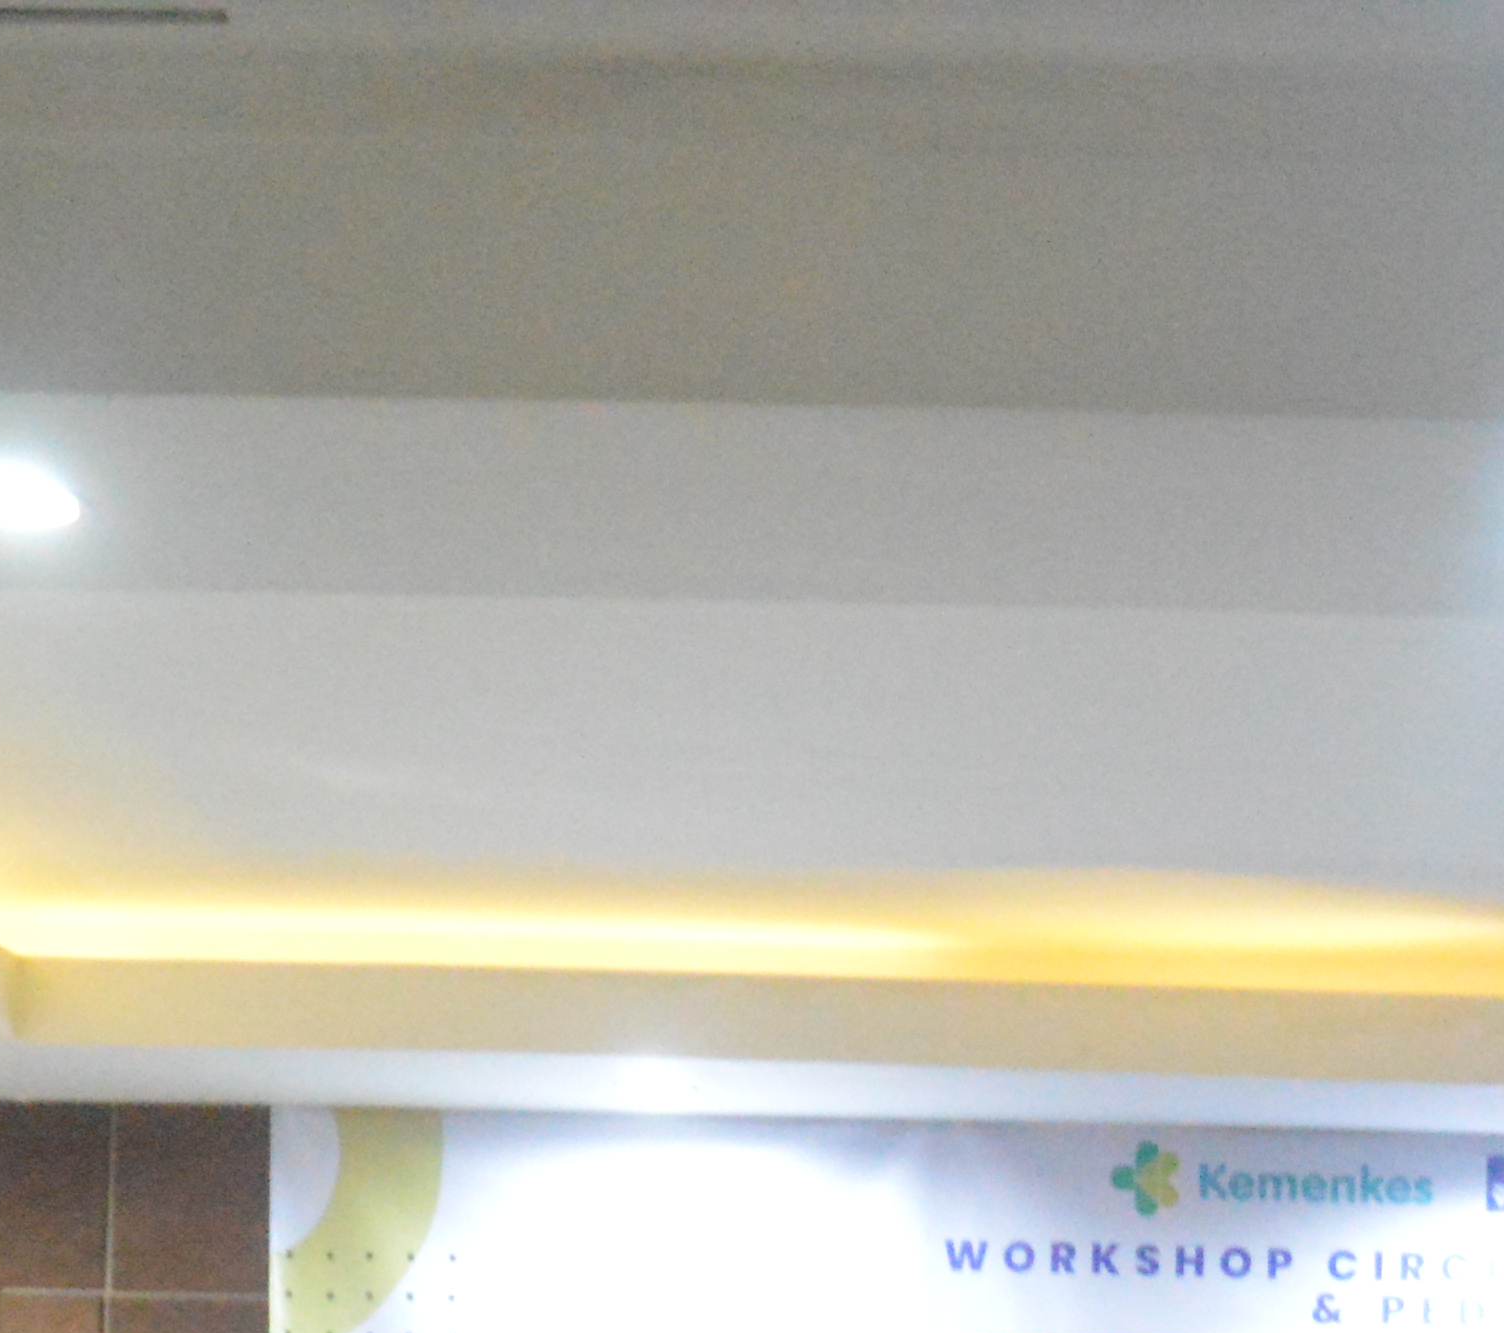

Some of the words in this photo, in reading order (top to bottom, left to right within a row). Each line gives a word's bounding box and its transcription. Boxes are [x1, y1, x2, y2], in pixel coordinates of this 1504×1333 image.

[1199, 1163, 1434, 1206] Kemenkes
[944, 1239, 1293, 1279] WORKSHOP
[1312, 1293, 1341, 1323] &
